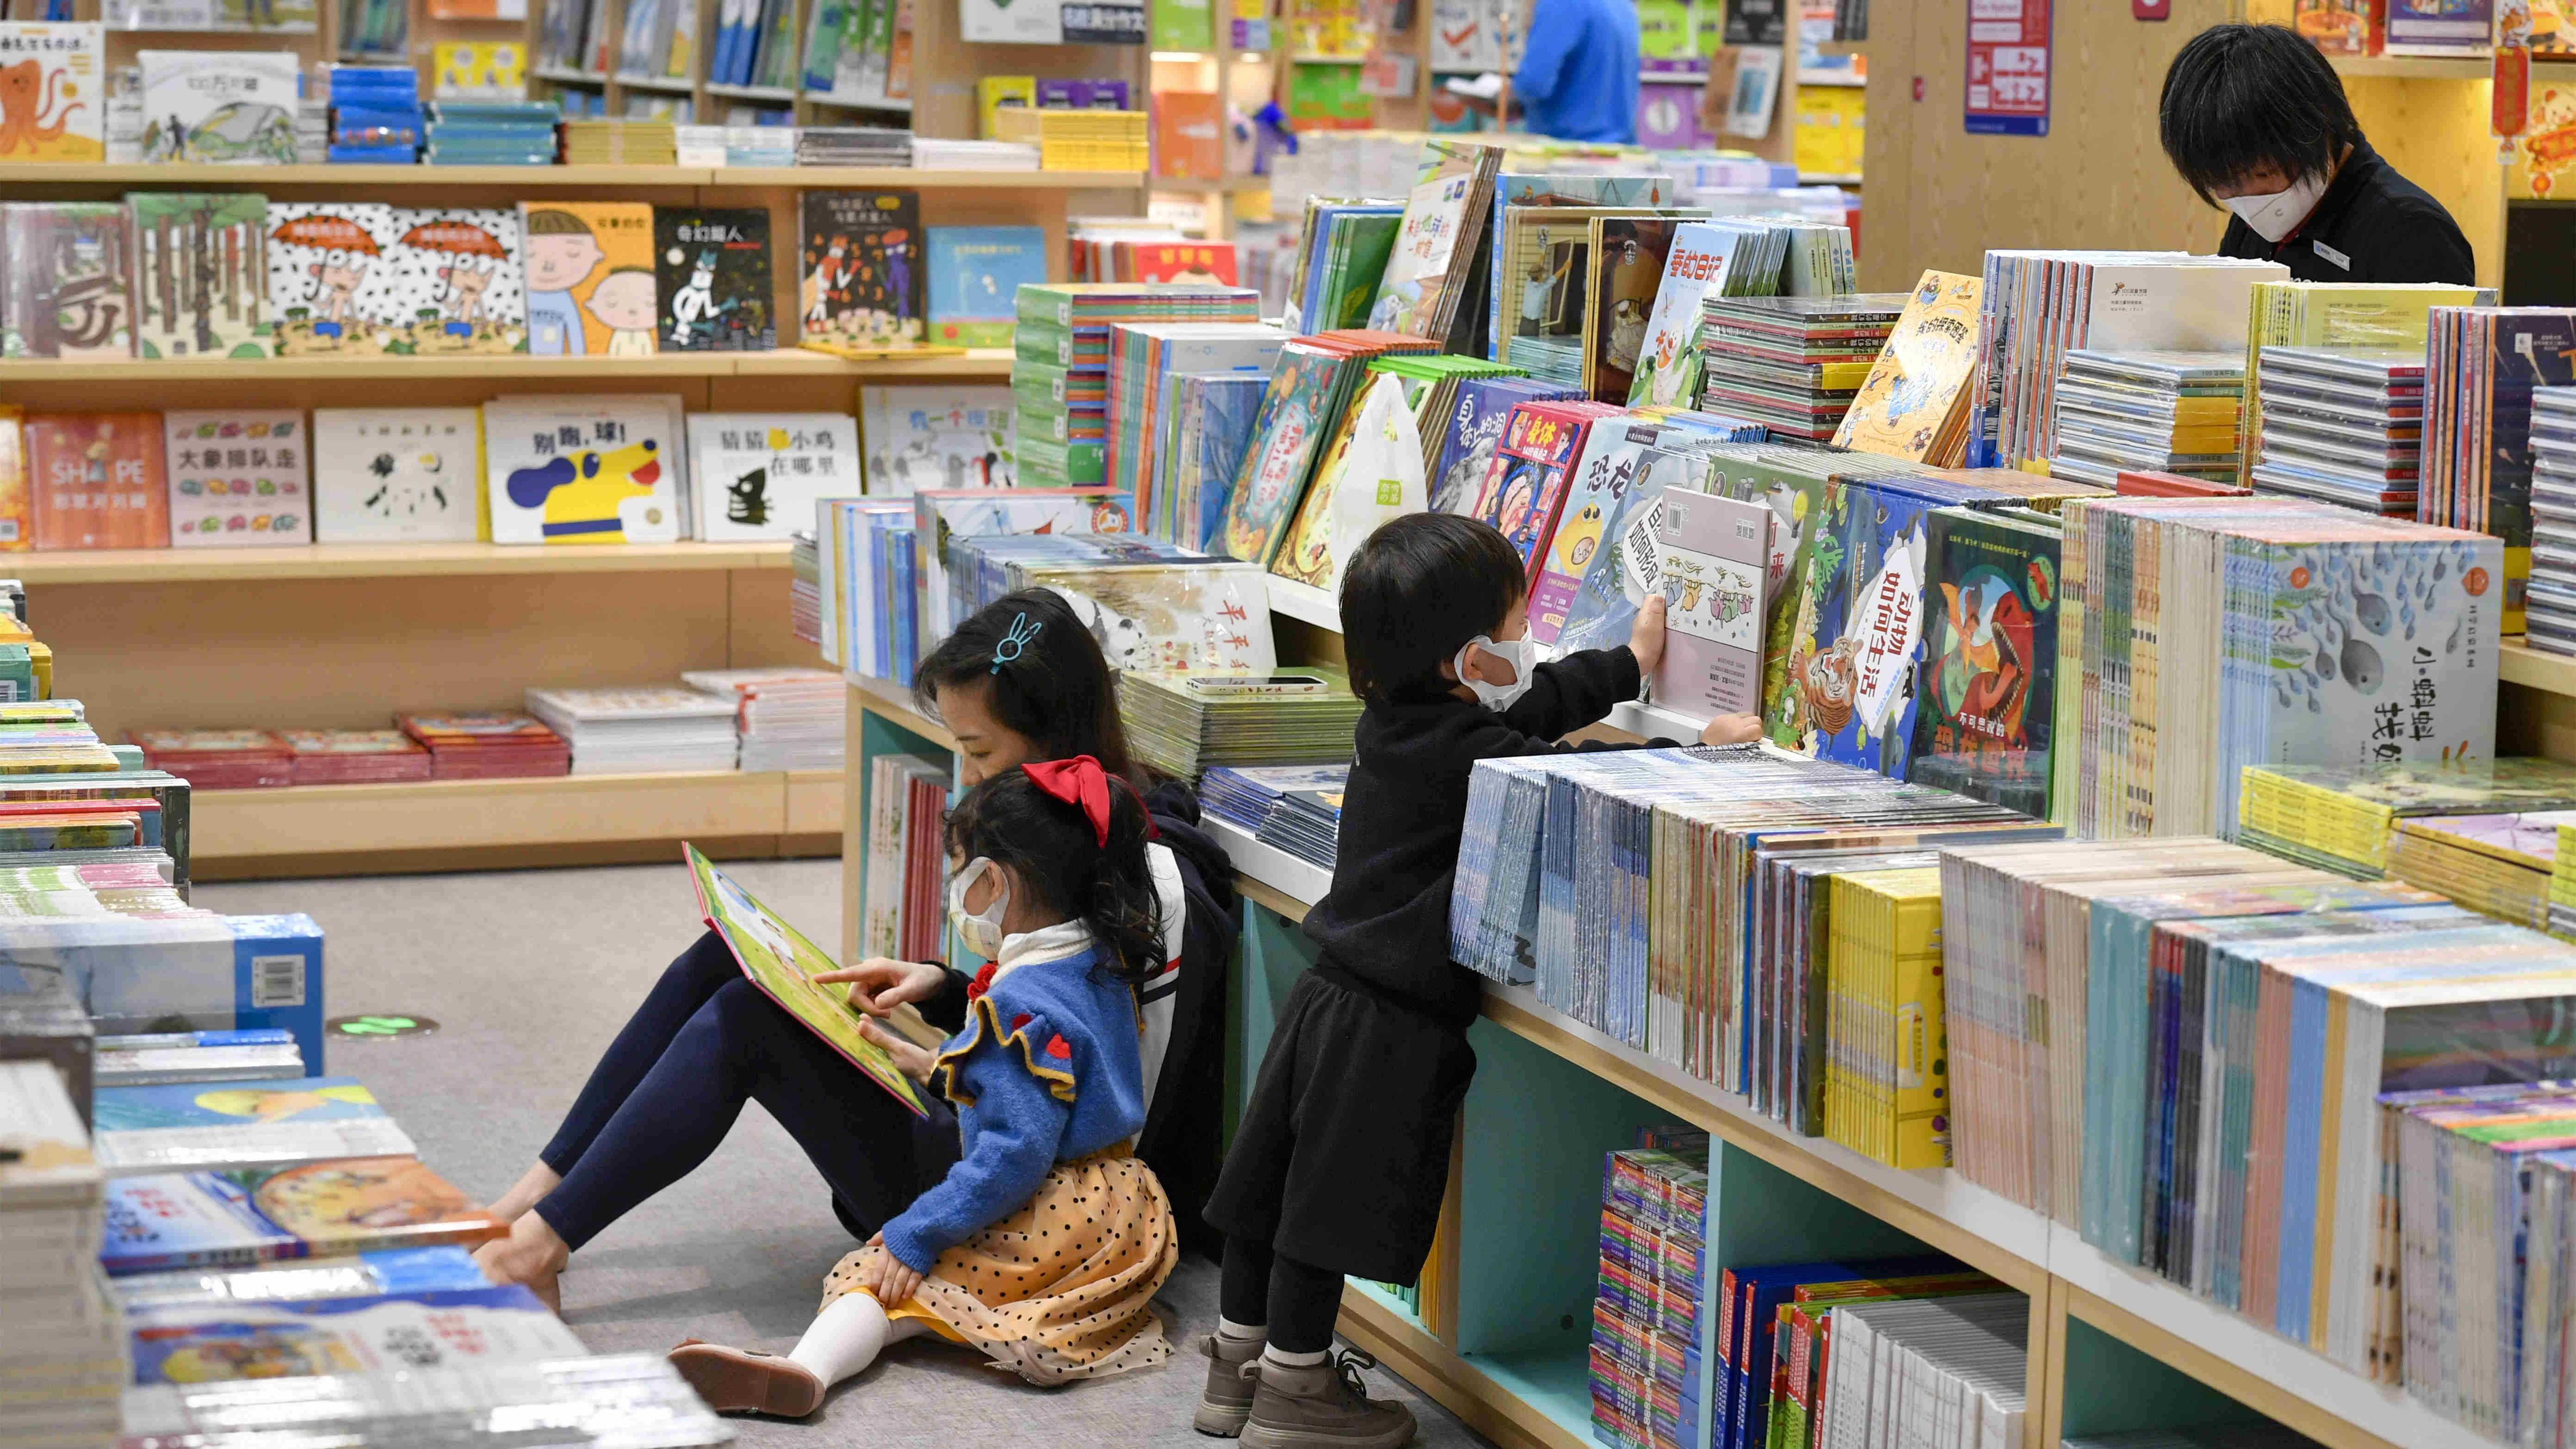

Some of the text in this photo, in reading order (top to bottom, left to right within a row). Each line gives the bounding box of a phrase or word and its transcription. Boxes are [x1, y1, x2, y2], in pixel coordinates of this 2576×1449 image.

[1526, 415, 1557, 448] 身体
[1628, 519, 1660, 589] 如何形成
[1860, 570, 1901, 698] 如何生活
[1887, 591, 1913, 656] 动物
[2409, 646, 2436, 742] 小蝌蚪
